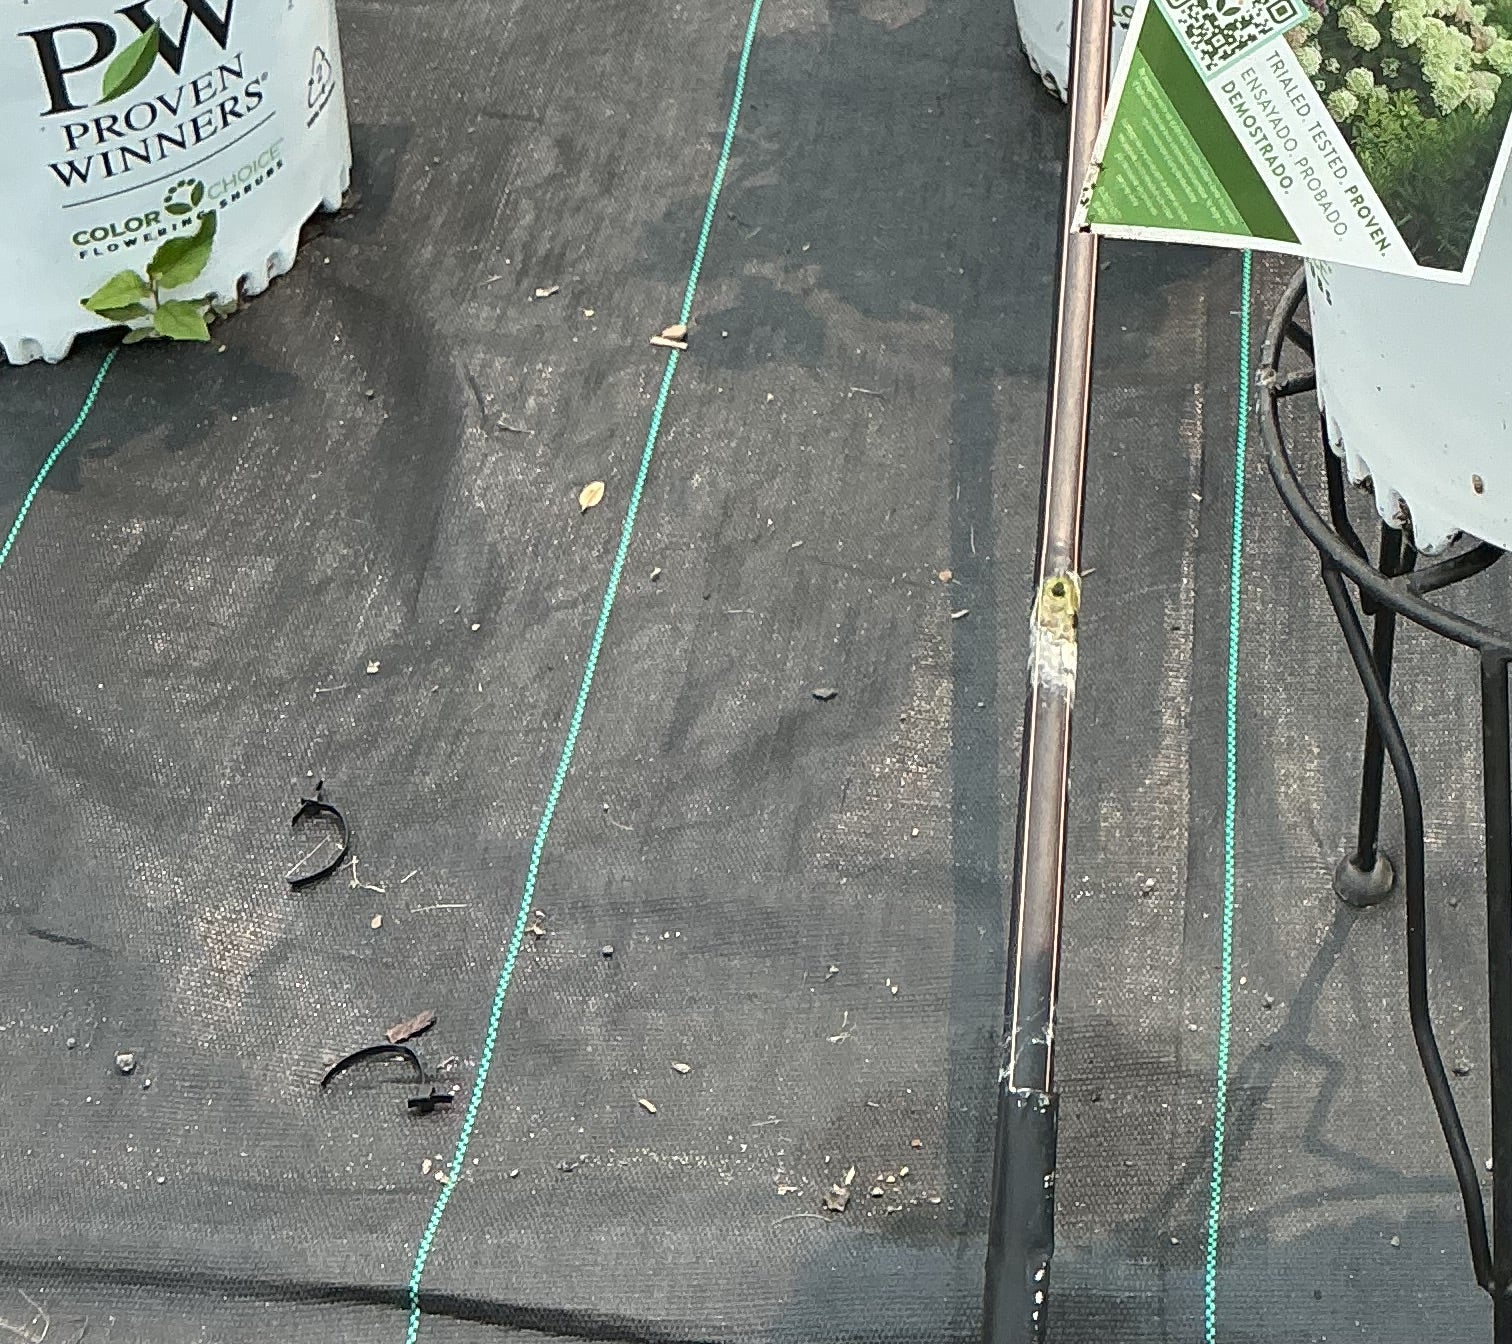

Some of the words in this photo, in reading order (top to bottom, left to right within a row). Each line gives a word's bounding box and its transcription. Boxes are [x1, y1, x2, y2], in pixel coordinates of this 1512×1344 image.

[48, 80, 265, 189] WINNERS
[62, 53, 245, 152] PROVEN
[1221, 80, 1293, 195] DEMOSTRADO.
[1240, 67, 1298, 158] ENSAYADO.
[1295, 157, 1348, 242] PROBADO.
[1266, 50, 1311, 123] TRIALED.
[1308, 120, 1348, 185] TESTED.
[1344, 184, 1391, 257] PROVEN.
[207, 144, 282, 201] CHOICE
[72, 211, 161, 247] COLOR
